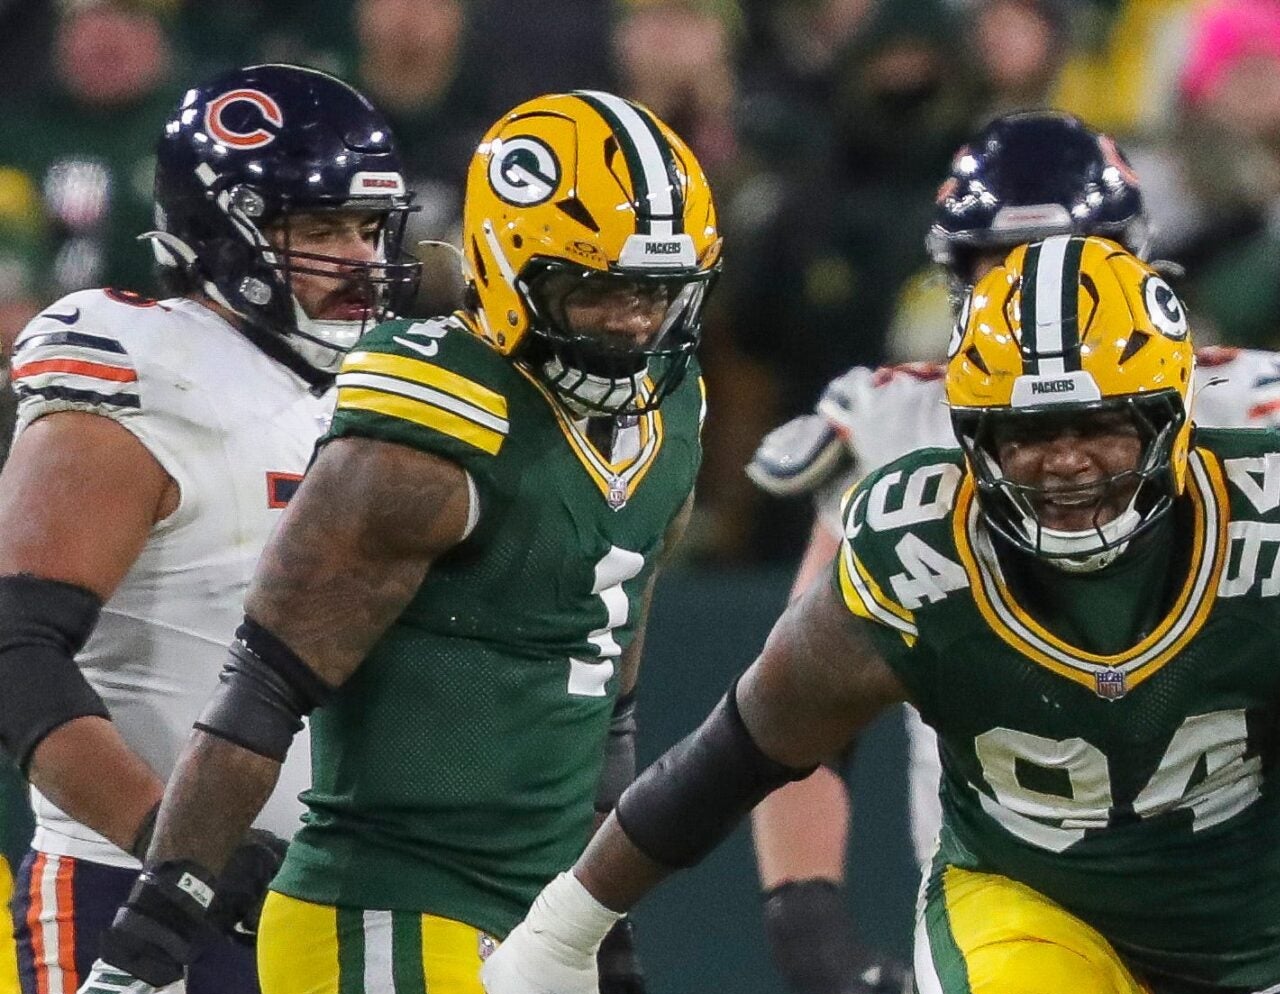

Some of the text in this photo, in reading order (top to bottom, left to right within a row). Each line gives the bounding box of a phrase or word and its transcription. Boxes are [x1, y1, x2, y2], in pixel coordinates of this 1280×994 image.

[644, 242, 681, 254] PACKERS
[1031, 379, 1075, 395] PACKERS
[866, 464, 969, 610] 94
[568, 545, 645, 697] 1
[967, 709, 1264, 853] 94
